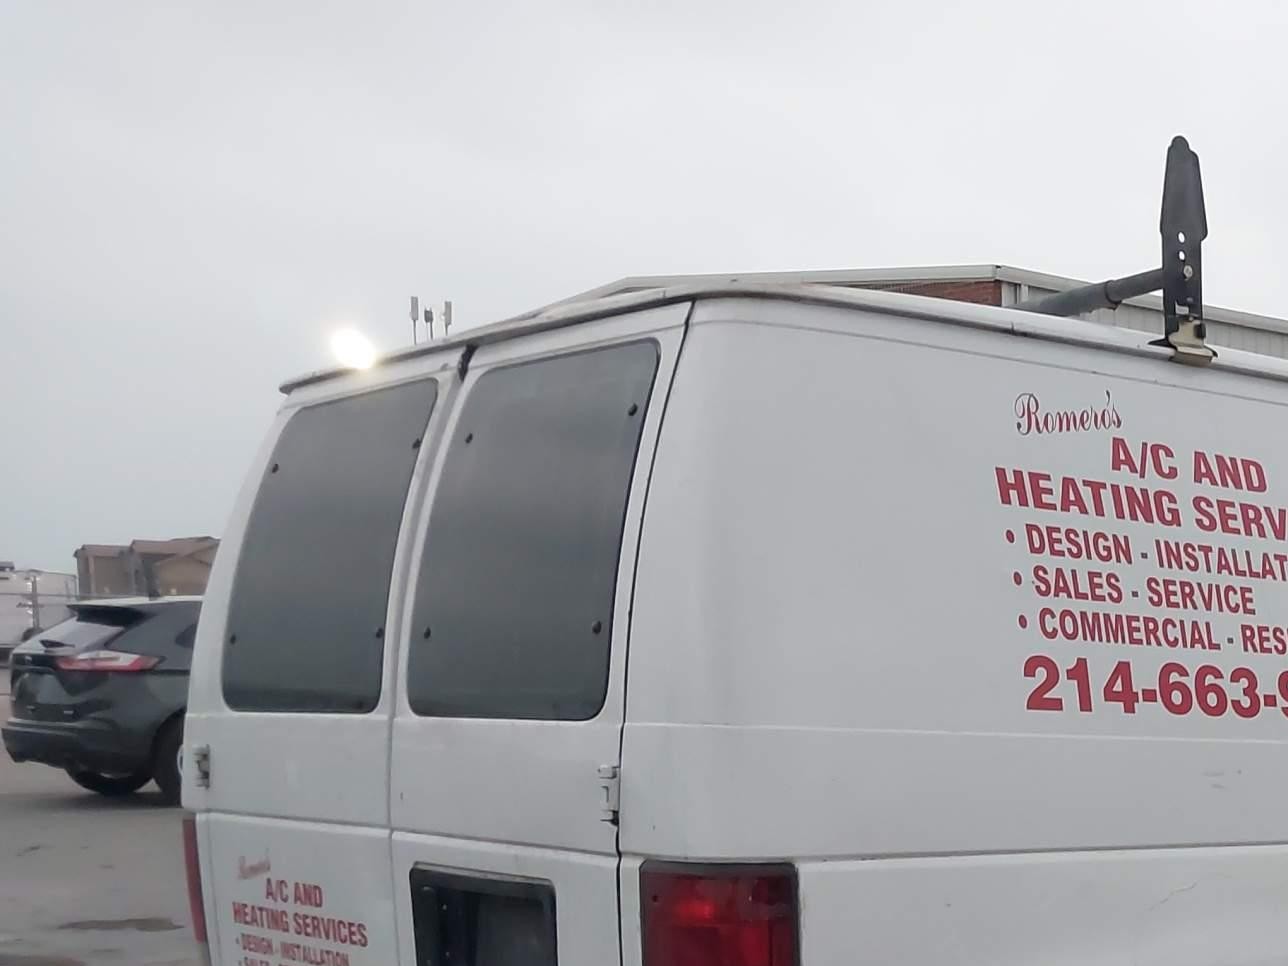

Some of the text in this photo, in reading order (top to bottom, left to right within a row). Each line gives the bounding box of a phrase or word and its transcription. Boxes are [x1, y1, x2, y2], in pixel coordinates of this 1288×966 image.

[1015, 389, 1121, 435] Romero's
[1110, 437, 1267, 493] A/C AND
[995, 467, 1181, 527] HEATING
[1025, 523, 1132, 564] DESIGN
[1033, 565, 1122, 603] SALES
[1146, 577, 1256, 616] SERVICE
[1038, 607, 1221, 650] COMMERCIAL
[266, 877, 323, 907] A/C AND
[232, 901, 368, 947] HEATING SERVICES
